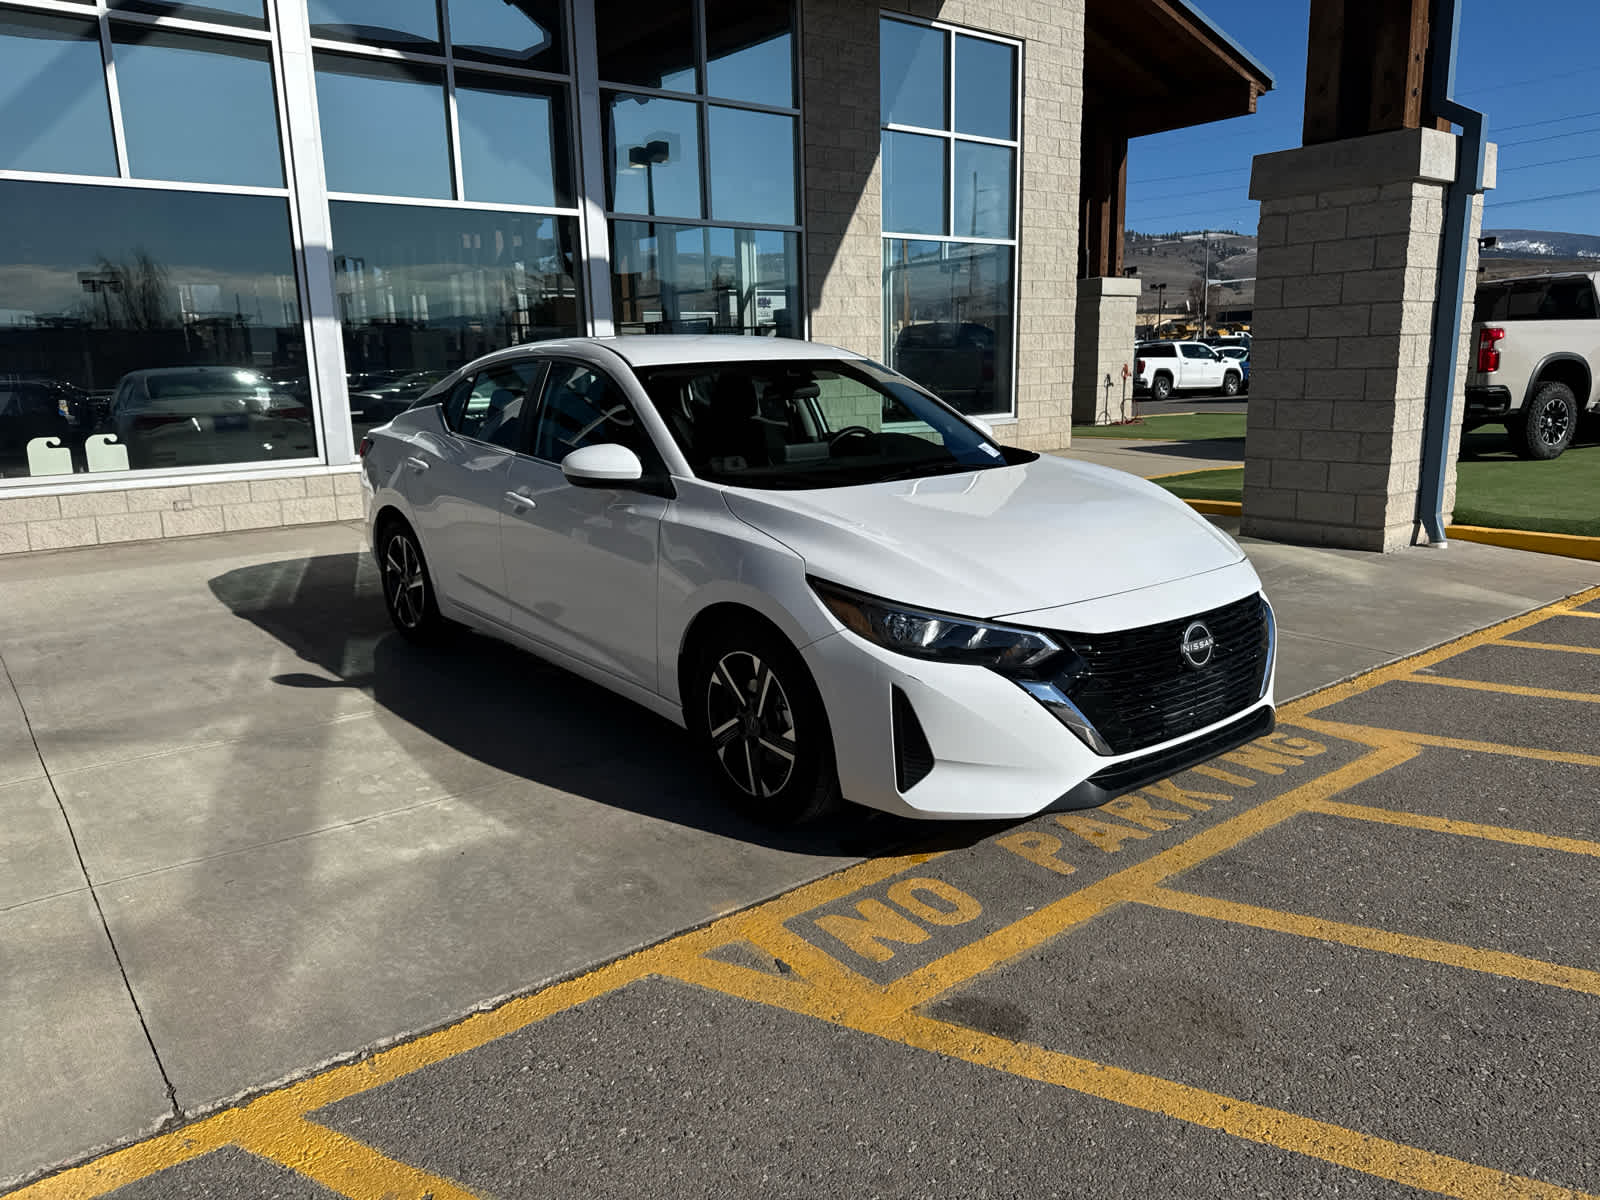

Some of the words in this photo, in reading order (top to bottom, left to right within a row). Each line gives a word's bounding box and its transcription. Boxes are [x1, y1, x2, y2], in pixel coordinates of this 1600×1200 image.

[1182, 638, 1213, 653] NISSAN
[814, 877, 982, 963] NO
[994, 732, 1328, 876] PARKING
